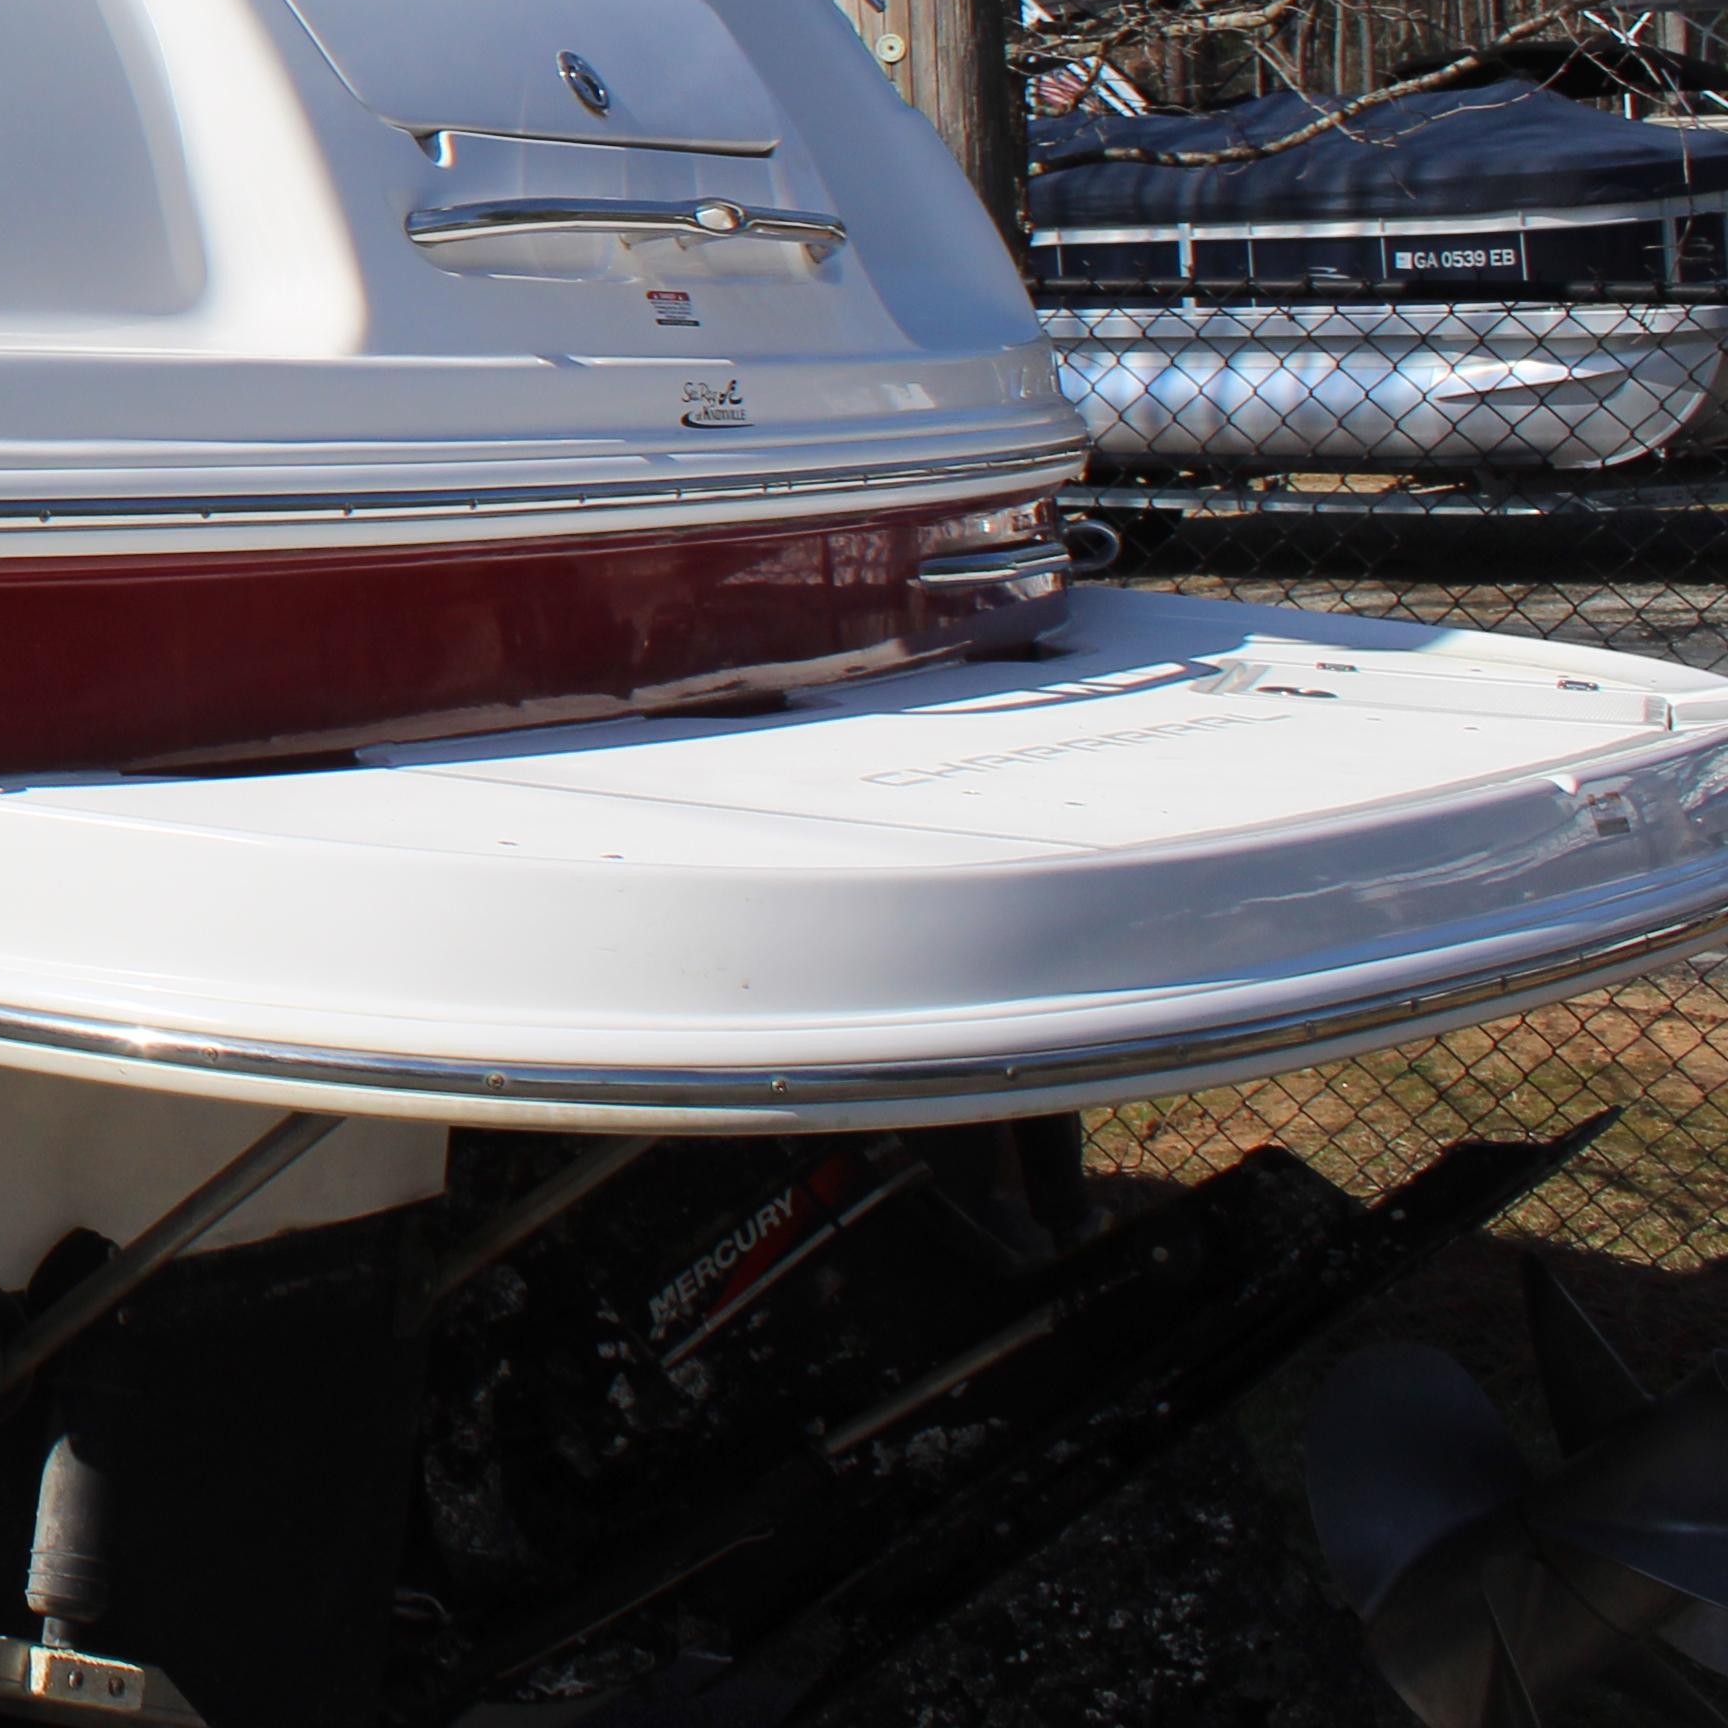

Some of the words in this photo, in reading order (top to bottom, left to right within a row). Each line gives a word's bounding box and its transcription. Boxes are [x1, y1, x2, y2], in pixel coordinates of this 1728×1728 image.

[1413, 251, 1439, 269] GA
[1441, 249, 1486, 268] 0539
[1489, 248, 1515, 267] EB
[860, 712, 1293, 786] CHAPARRAL
[648, 1186, 793, 1327] MERCURY
